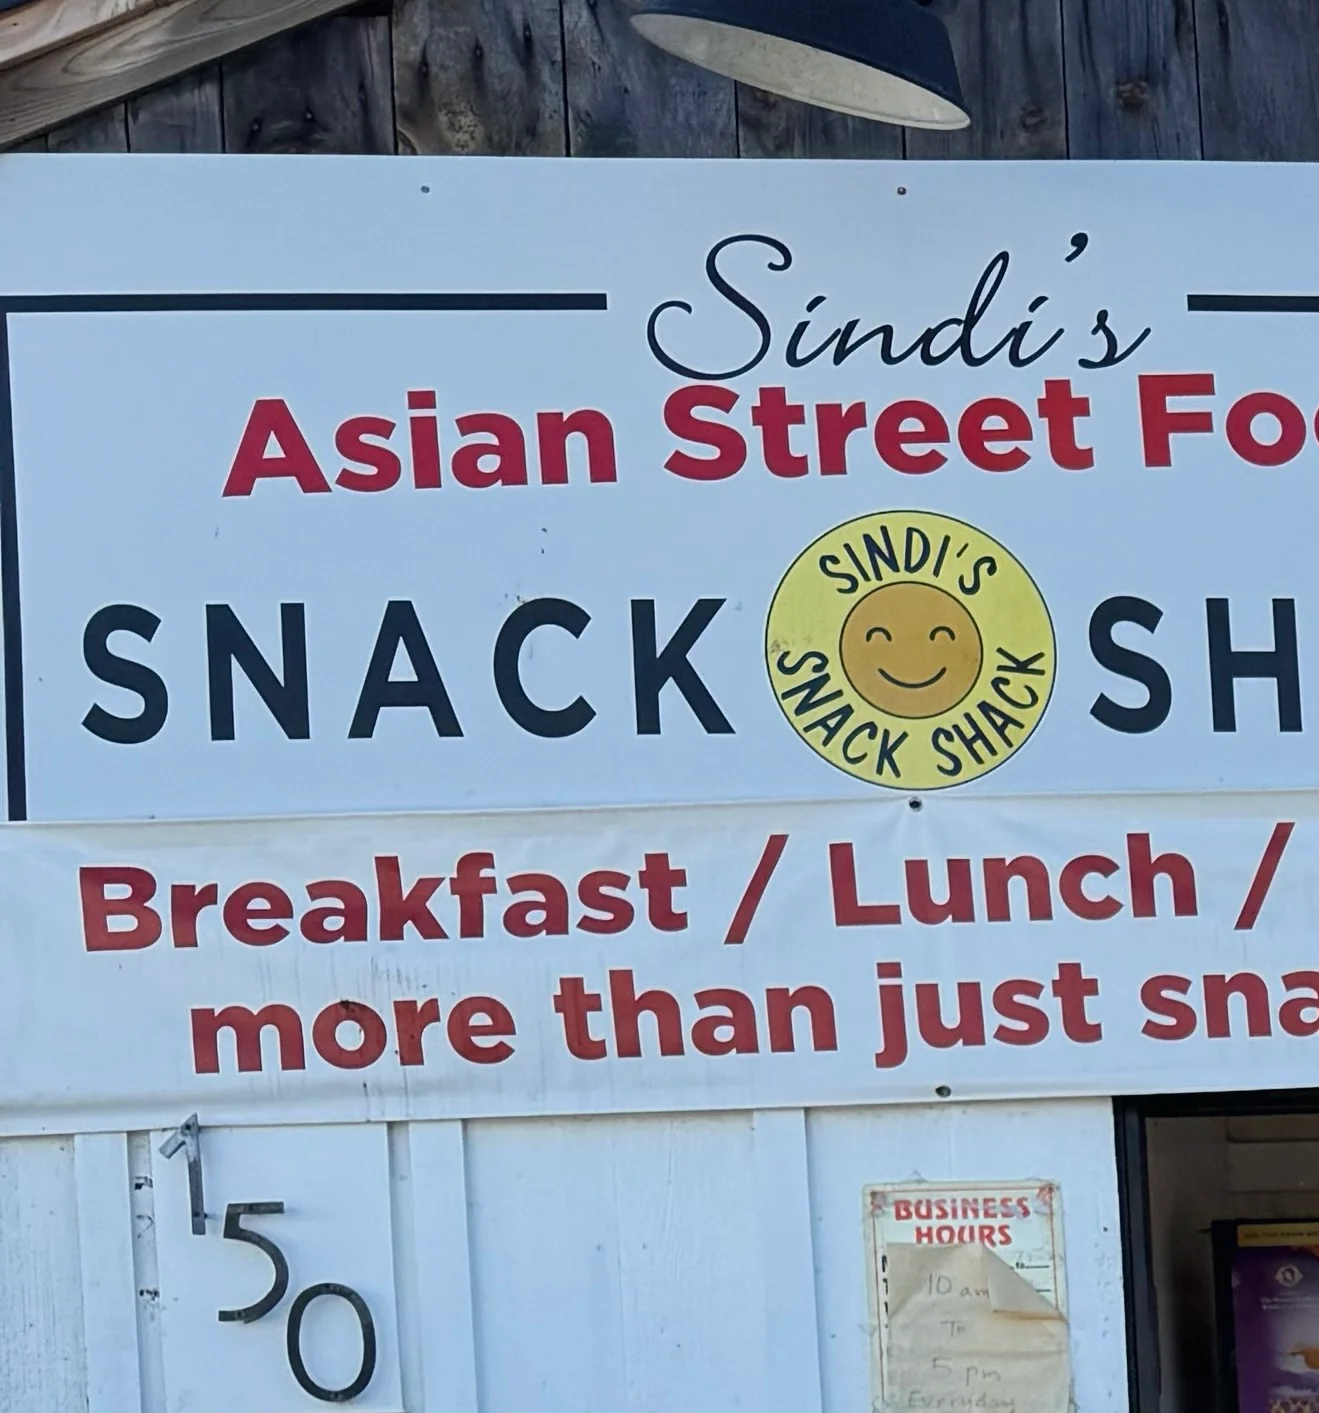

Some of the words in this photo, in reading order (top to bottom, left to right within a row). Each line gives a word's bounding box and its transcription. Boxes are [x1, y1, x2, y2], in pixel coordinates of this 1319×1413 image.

[647, 232, 1152, 381] Sindi's
[223, 389, 618, 498] Asian
[663, 364, 1095, 482] Street
[819, 524, 998, 596] SINDI'S
[82, 597, 737, 746] SNACK
[776, 650, 909, 779] SNACK
[931, 646, 1046, 778] SHACK
[79, 851, 688, 952] Breakfast
[724, 834, 789, 945] /
[829, 833, 1199, 926] Lunch
[1233, 822, 1296, 931] /
[191, 998, 517, 1074] more
[553, 969, 838, 1060] than
[875, 961, 1104, 1068] just
[158, 1112, 377, 1403] 150
[894, 1197, 1031, 1221] BUSINESS
[914, 1224, 1013, 1247] HOURS
[928, 1272, 953, 1297] 10
